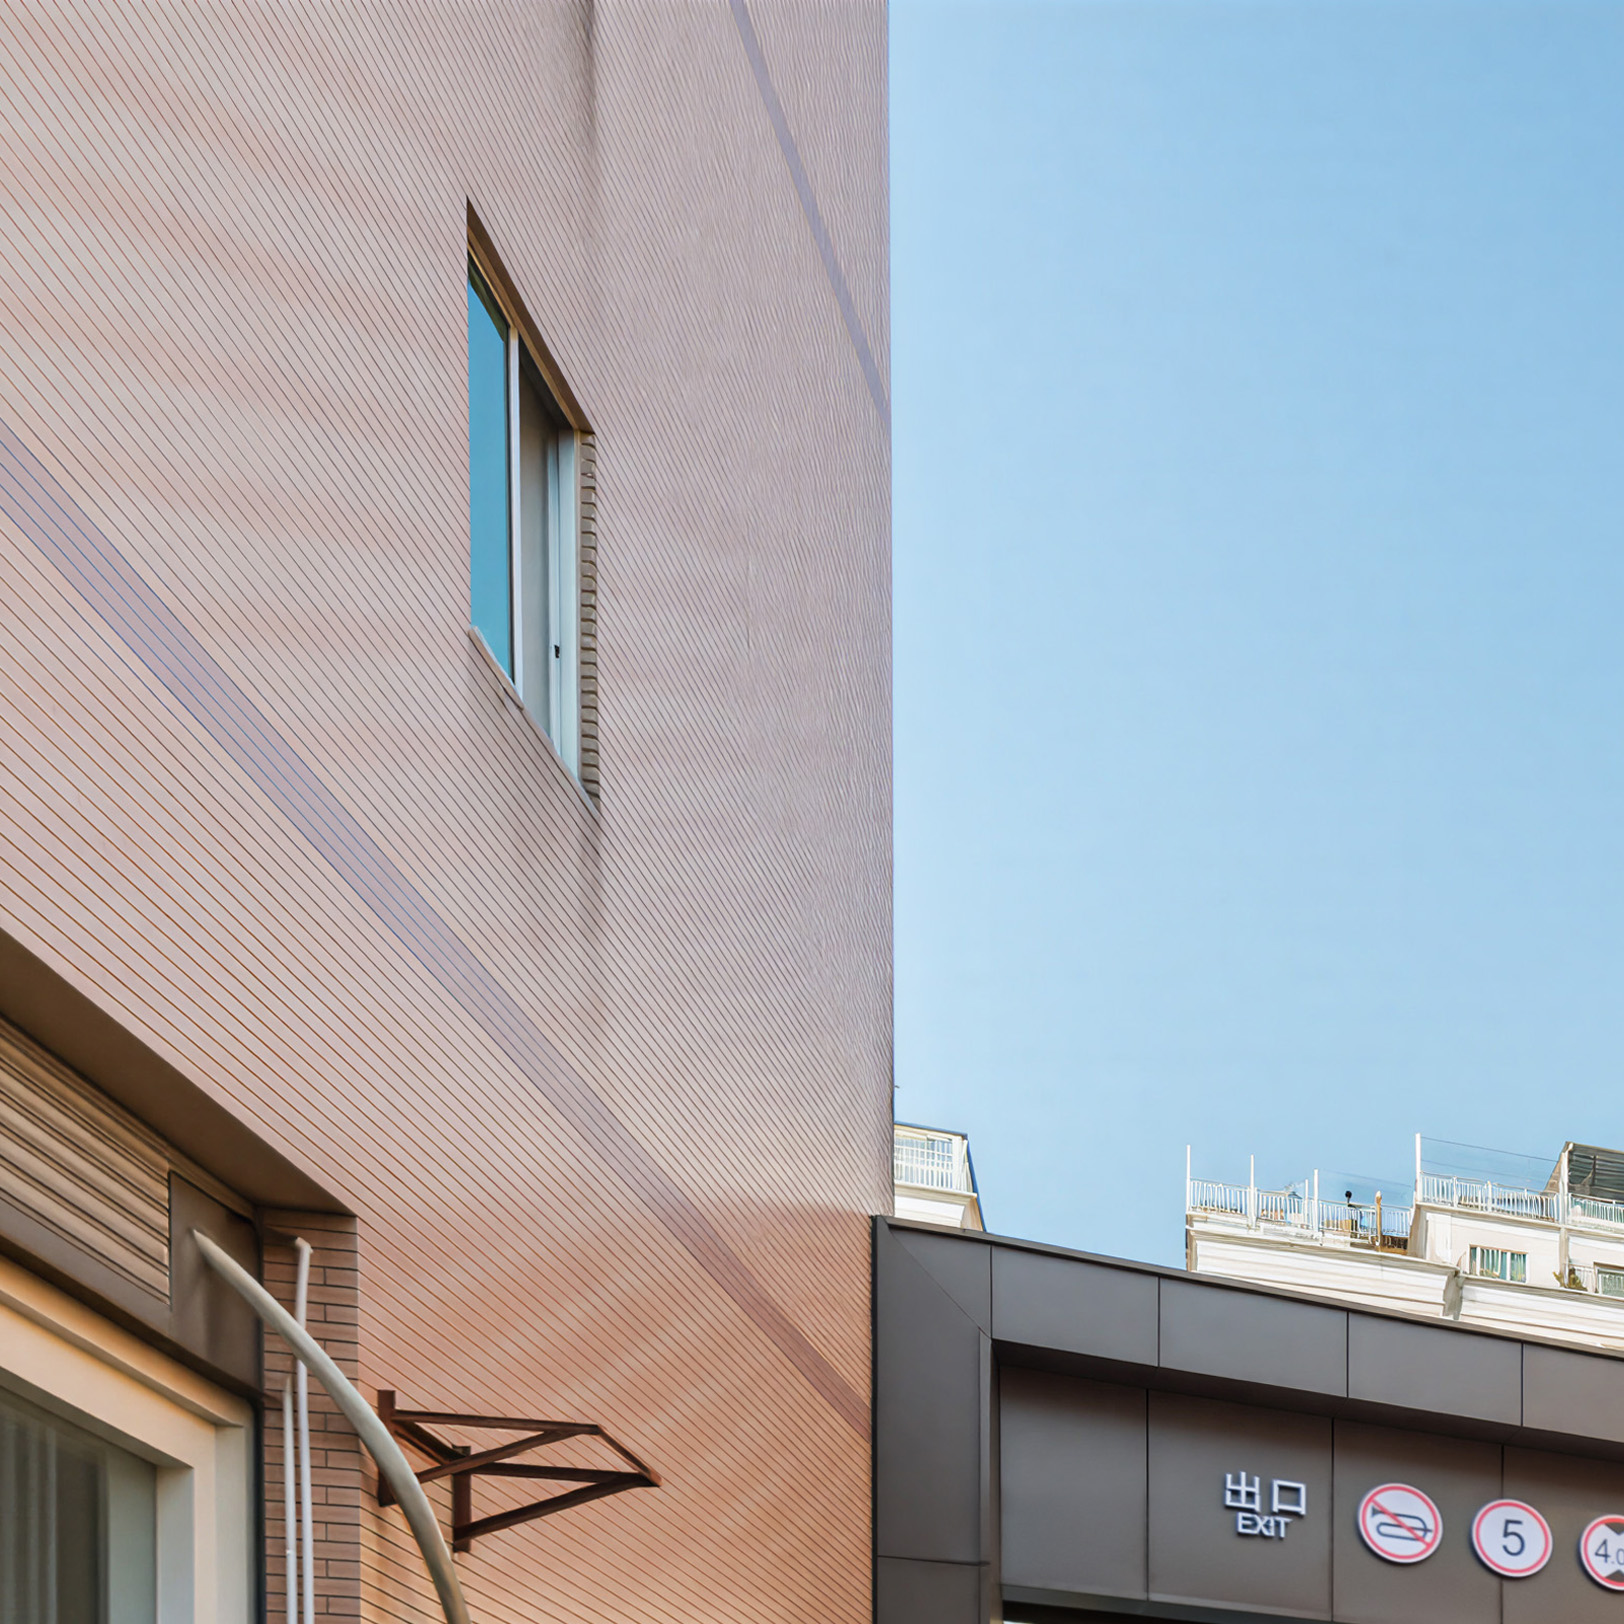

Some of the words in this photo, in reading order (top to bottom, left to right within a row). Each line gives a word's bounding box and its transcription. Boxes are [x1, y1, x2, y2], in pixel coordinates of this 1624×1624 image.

[1224, 1471, 1306, 1516] 出口
[1237, 1511, 1293, 1539] EXIT
[1502, 1519, 1525, 1556] 5
